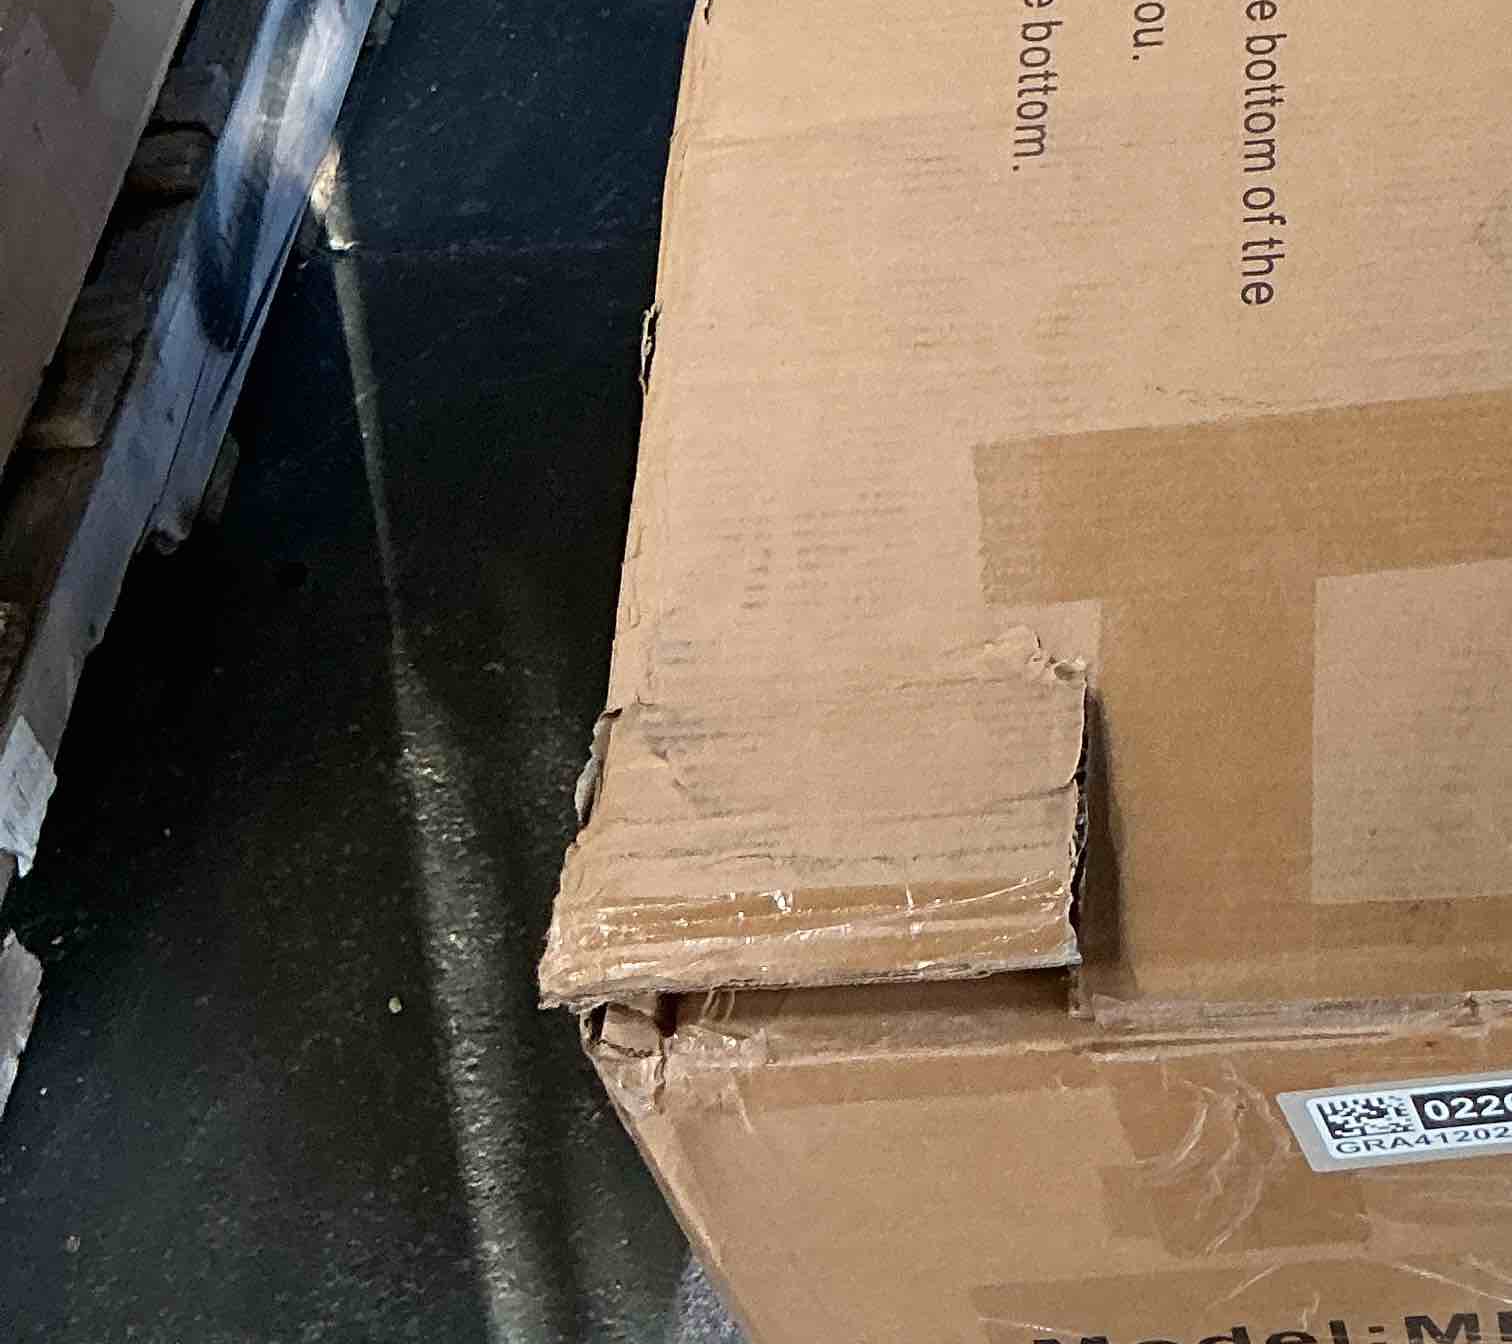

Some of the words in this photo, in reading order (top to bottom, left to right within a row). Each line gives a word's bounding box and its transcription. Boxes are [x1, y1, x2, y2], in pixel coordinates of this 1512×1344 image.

[1012, 21, 1063, 171] bottom.
[1243, 33, 1287, 173] bottom
[1242, 187, 1287, 225] of
[1241, 237, 1285, 305] the
